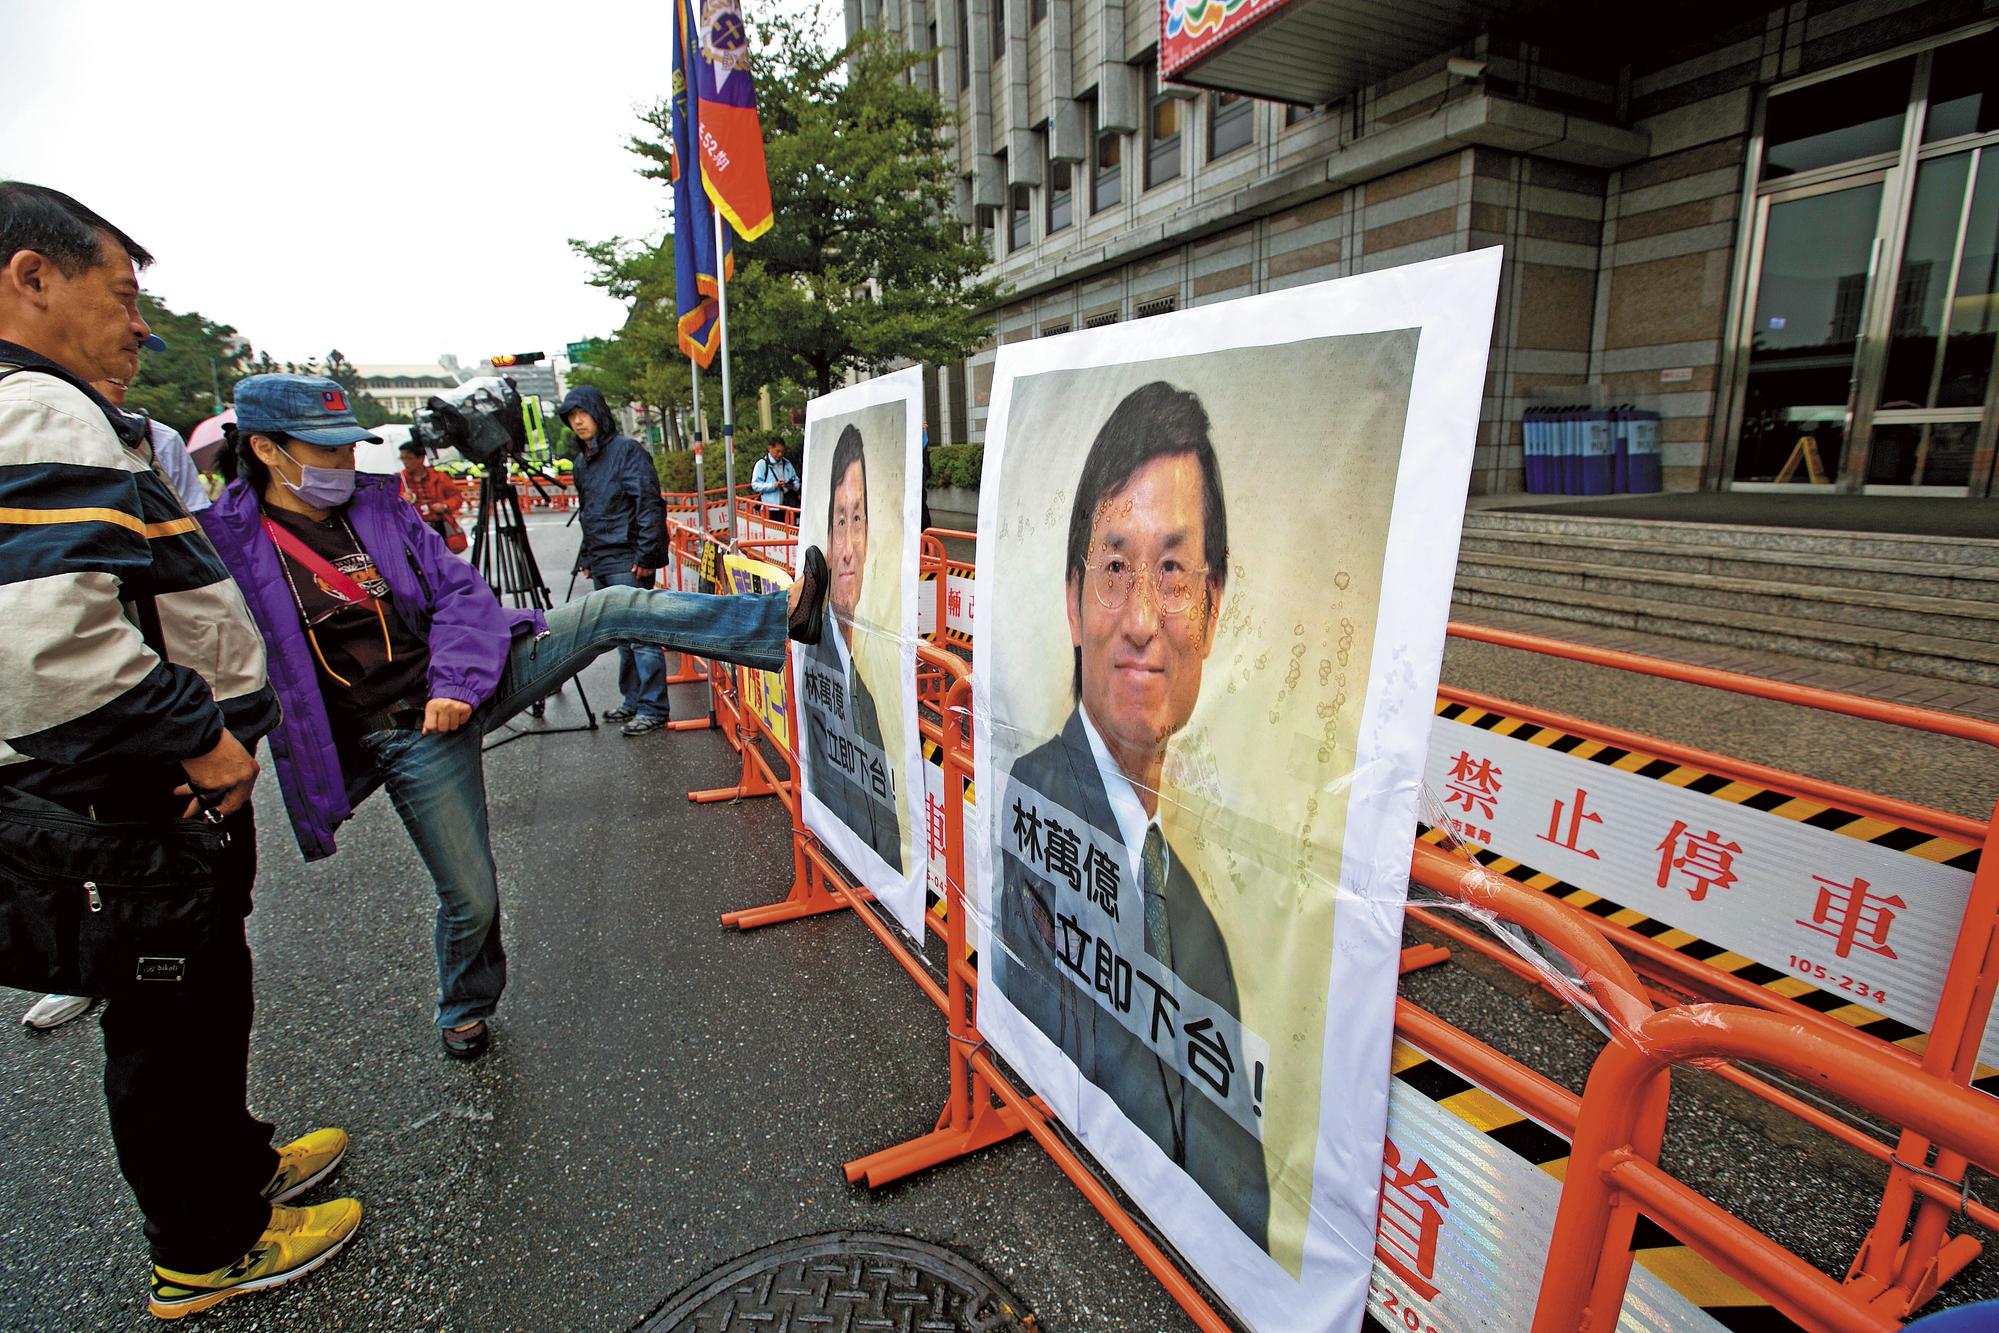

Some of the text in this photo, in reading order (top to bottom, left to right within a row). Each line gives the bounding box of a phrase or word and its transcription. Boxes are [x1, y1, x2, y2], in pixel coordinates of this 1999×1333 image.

[805, 666, 846, 721] 林萬億
[1013, 797, 1121, 923] 林萬億
[1444, 750, 1907, 960] 禁止停車
[1055, 912, 1265, 1118] 立即下台!
[1789, 955, 1887, 1004] 105-234
